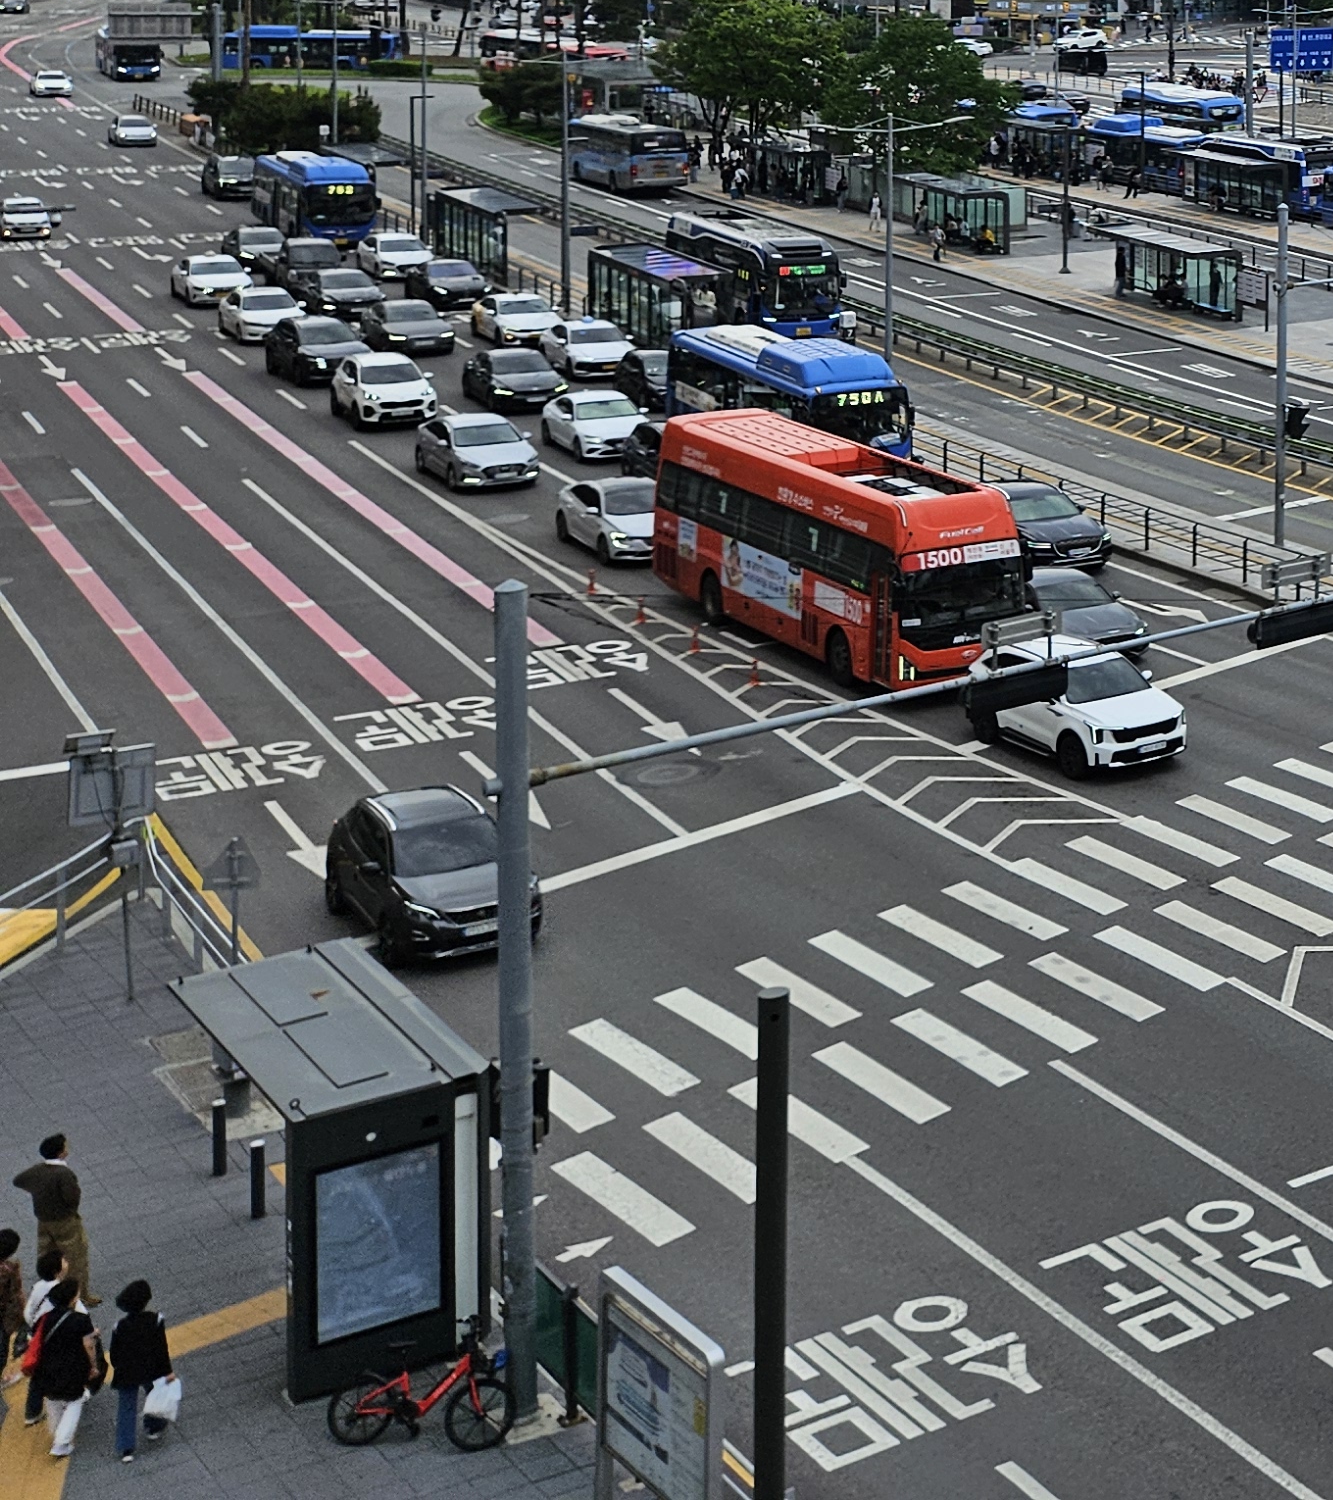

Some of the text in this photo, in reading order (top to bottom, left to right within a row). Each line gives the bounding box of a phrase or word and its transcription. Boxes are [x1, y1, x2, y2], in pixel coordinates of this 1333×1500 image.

[836, 391, 885, 407] 750A
[917, 547, 962, 570] 1500
[334, 695, 499, 752] 숭례문
[154, 740, 327, 801] 숭례문
[1039, 1199, 1332, 1353] 숭례문
[723, 1295, 1043, 1472] 숭례문
